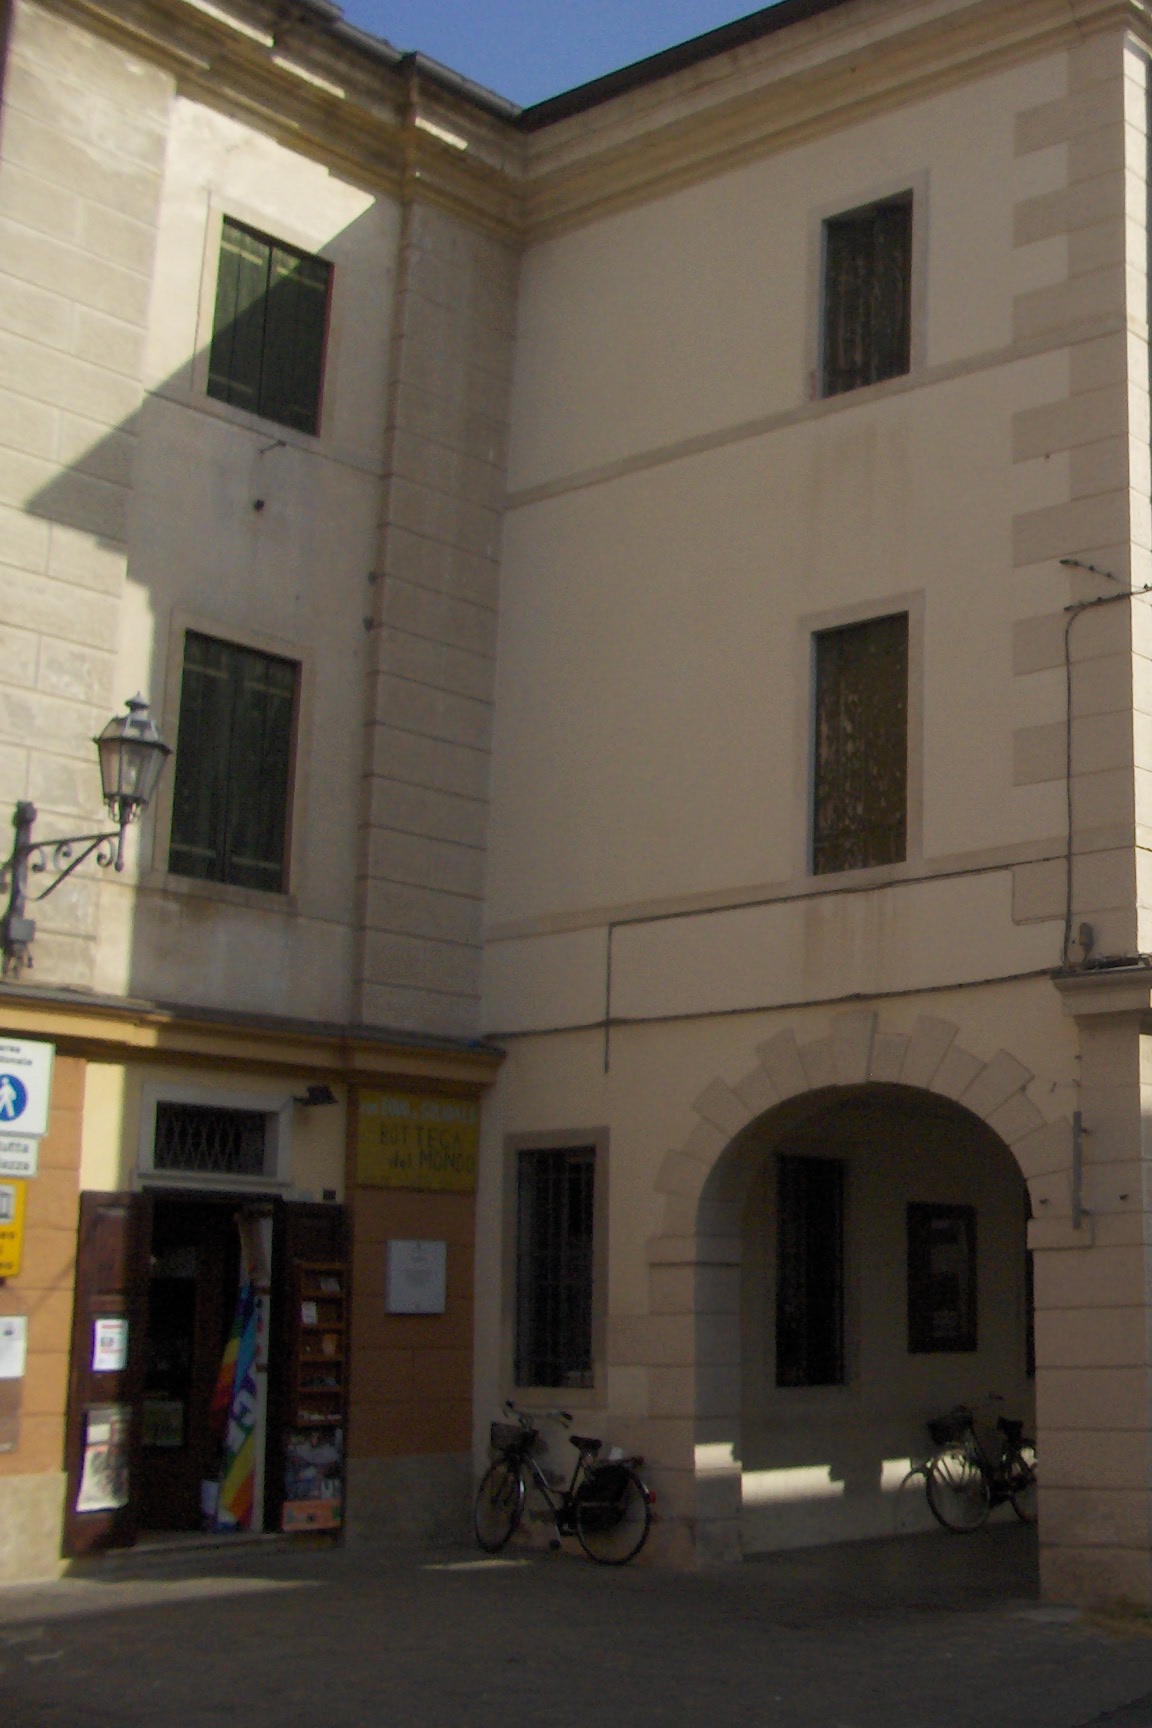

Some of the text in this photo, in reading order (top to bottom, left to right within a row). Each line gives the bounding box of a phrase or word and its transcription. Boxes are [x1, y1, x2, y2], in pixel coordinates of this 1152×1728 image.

[379, 1121, 463, 1151] BOTTEGA
[388, 1148, 477, 1176] del MONDO
